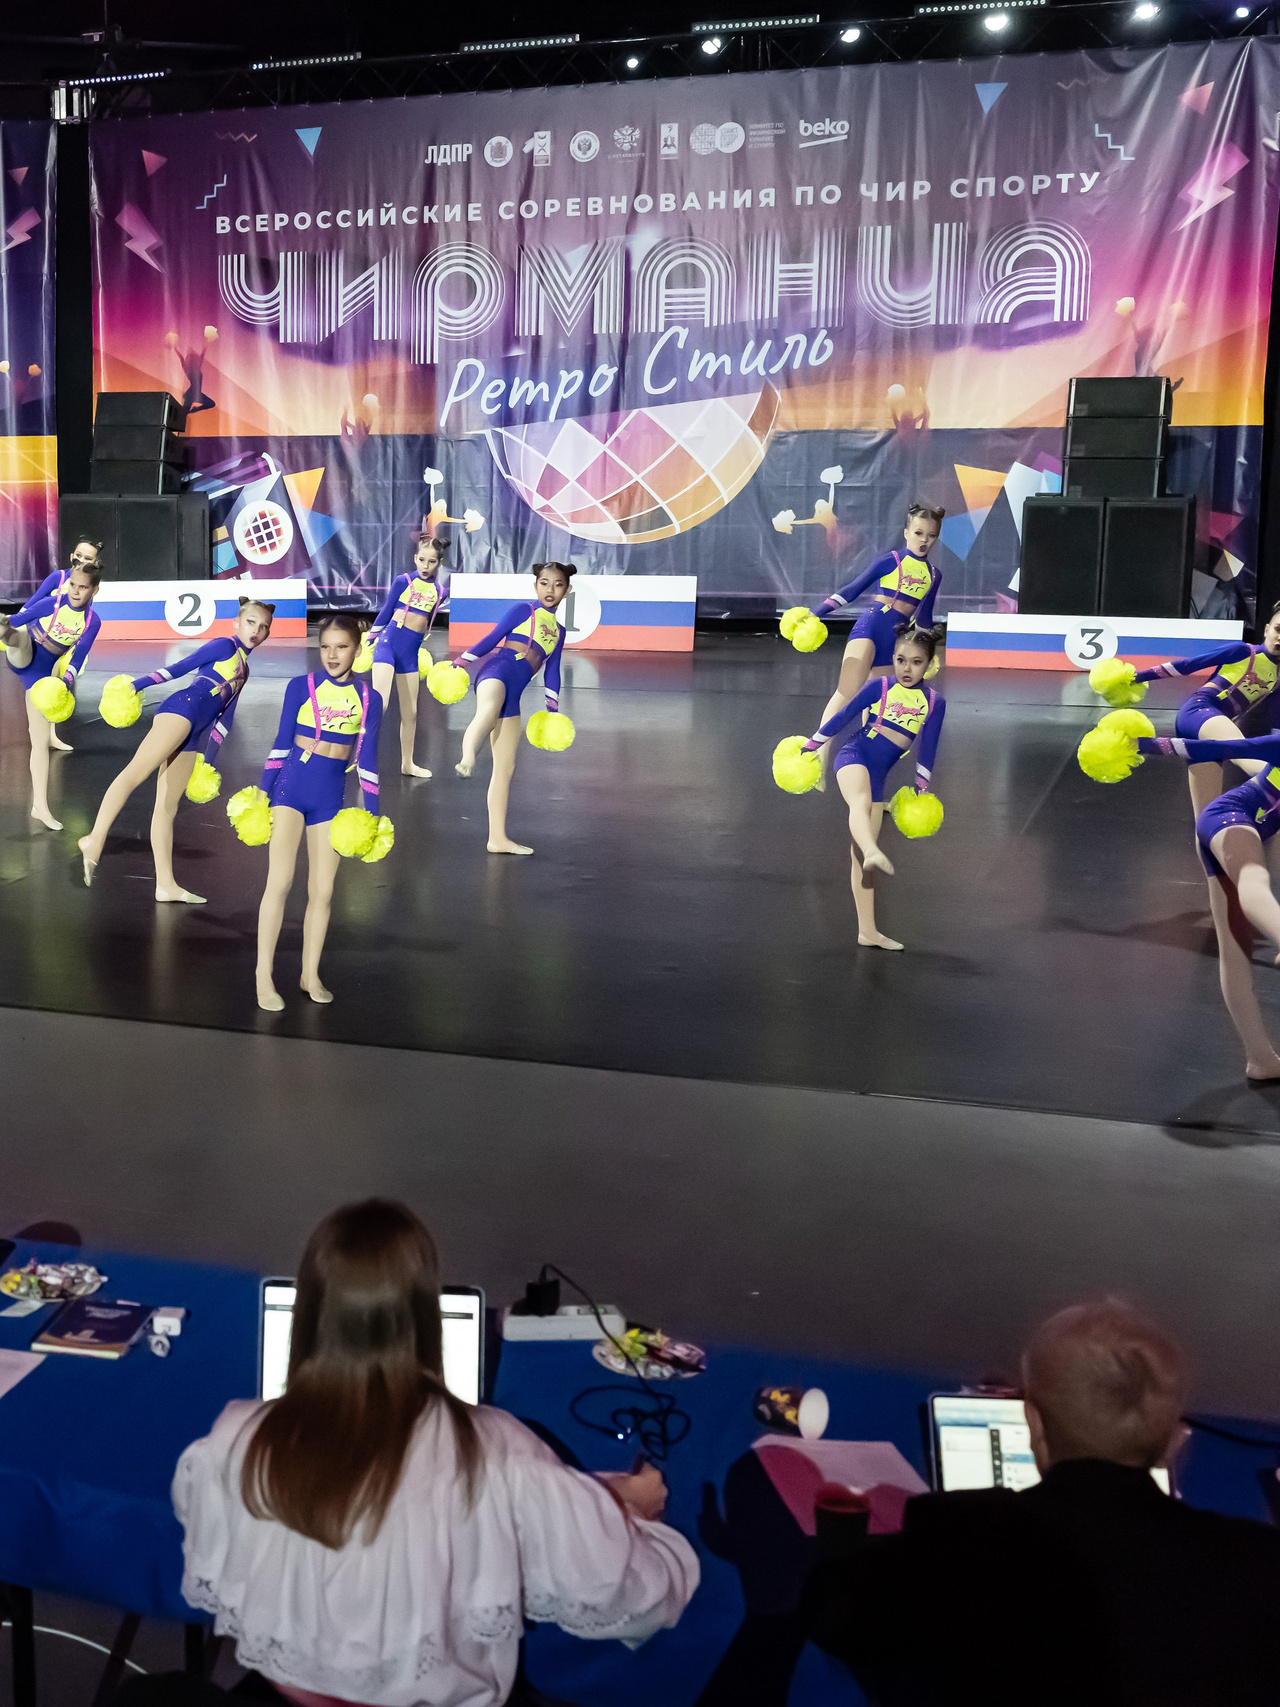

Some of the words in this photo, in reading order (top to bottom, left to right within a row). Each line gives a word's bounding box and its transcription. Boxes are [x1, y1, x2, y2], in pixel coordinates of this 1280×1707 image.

[799, 118, 850, 137] beko
[425, 143, 473, 167] ЛДПР
[216, 202, 482, 234] ВСЕРОССИЙСКИЕ
[498, 187, 776, 221] СОРЕВНОВАНИЯ
[795, 184, 842, 206] ПО
[861, 180, 932, 203] ЧИР
[950, 171, 1102, 199] СПОРТУ
[440, 357, 618, 428] Ретро
[643, 326, 835, 396] Стиль
[177, 592, 203, 627] 2
[564, 591, 580, 632] 1
[1078, 627, 1104, 661] 3
